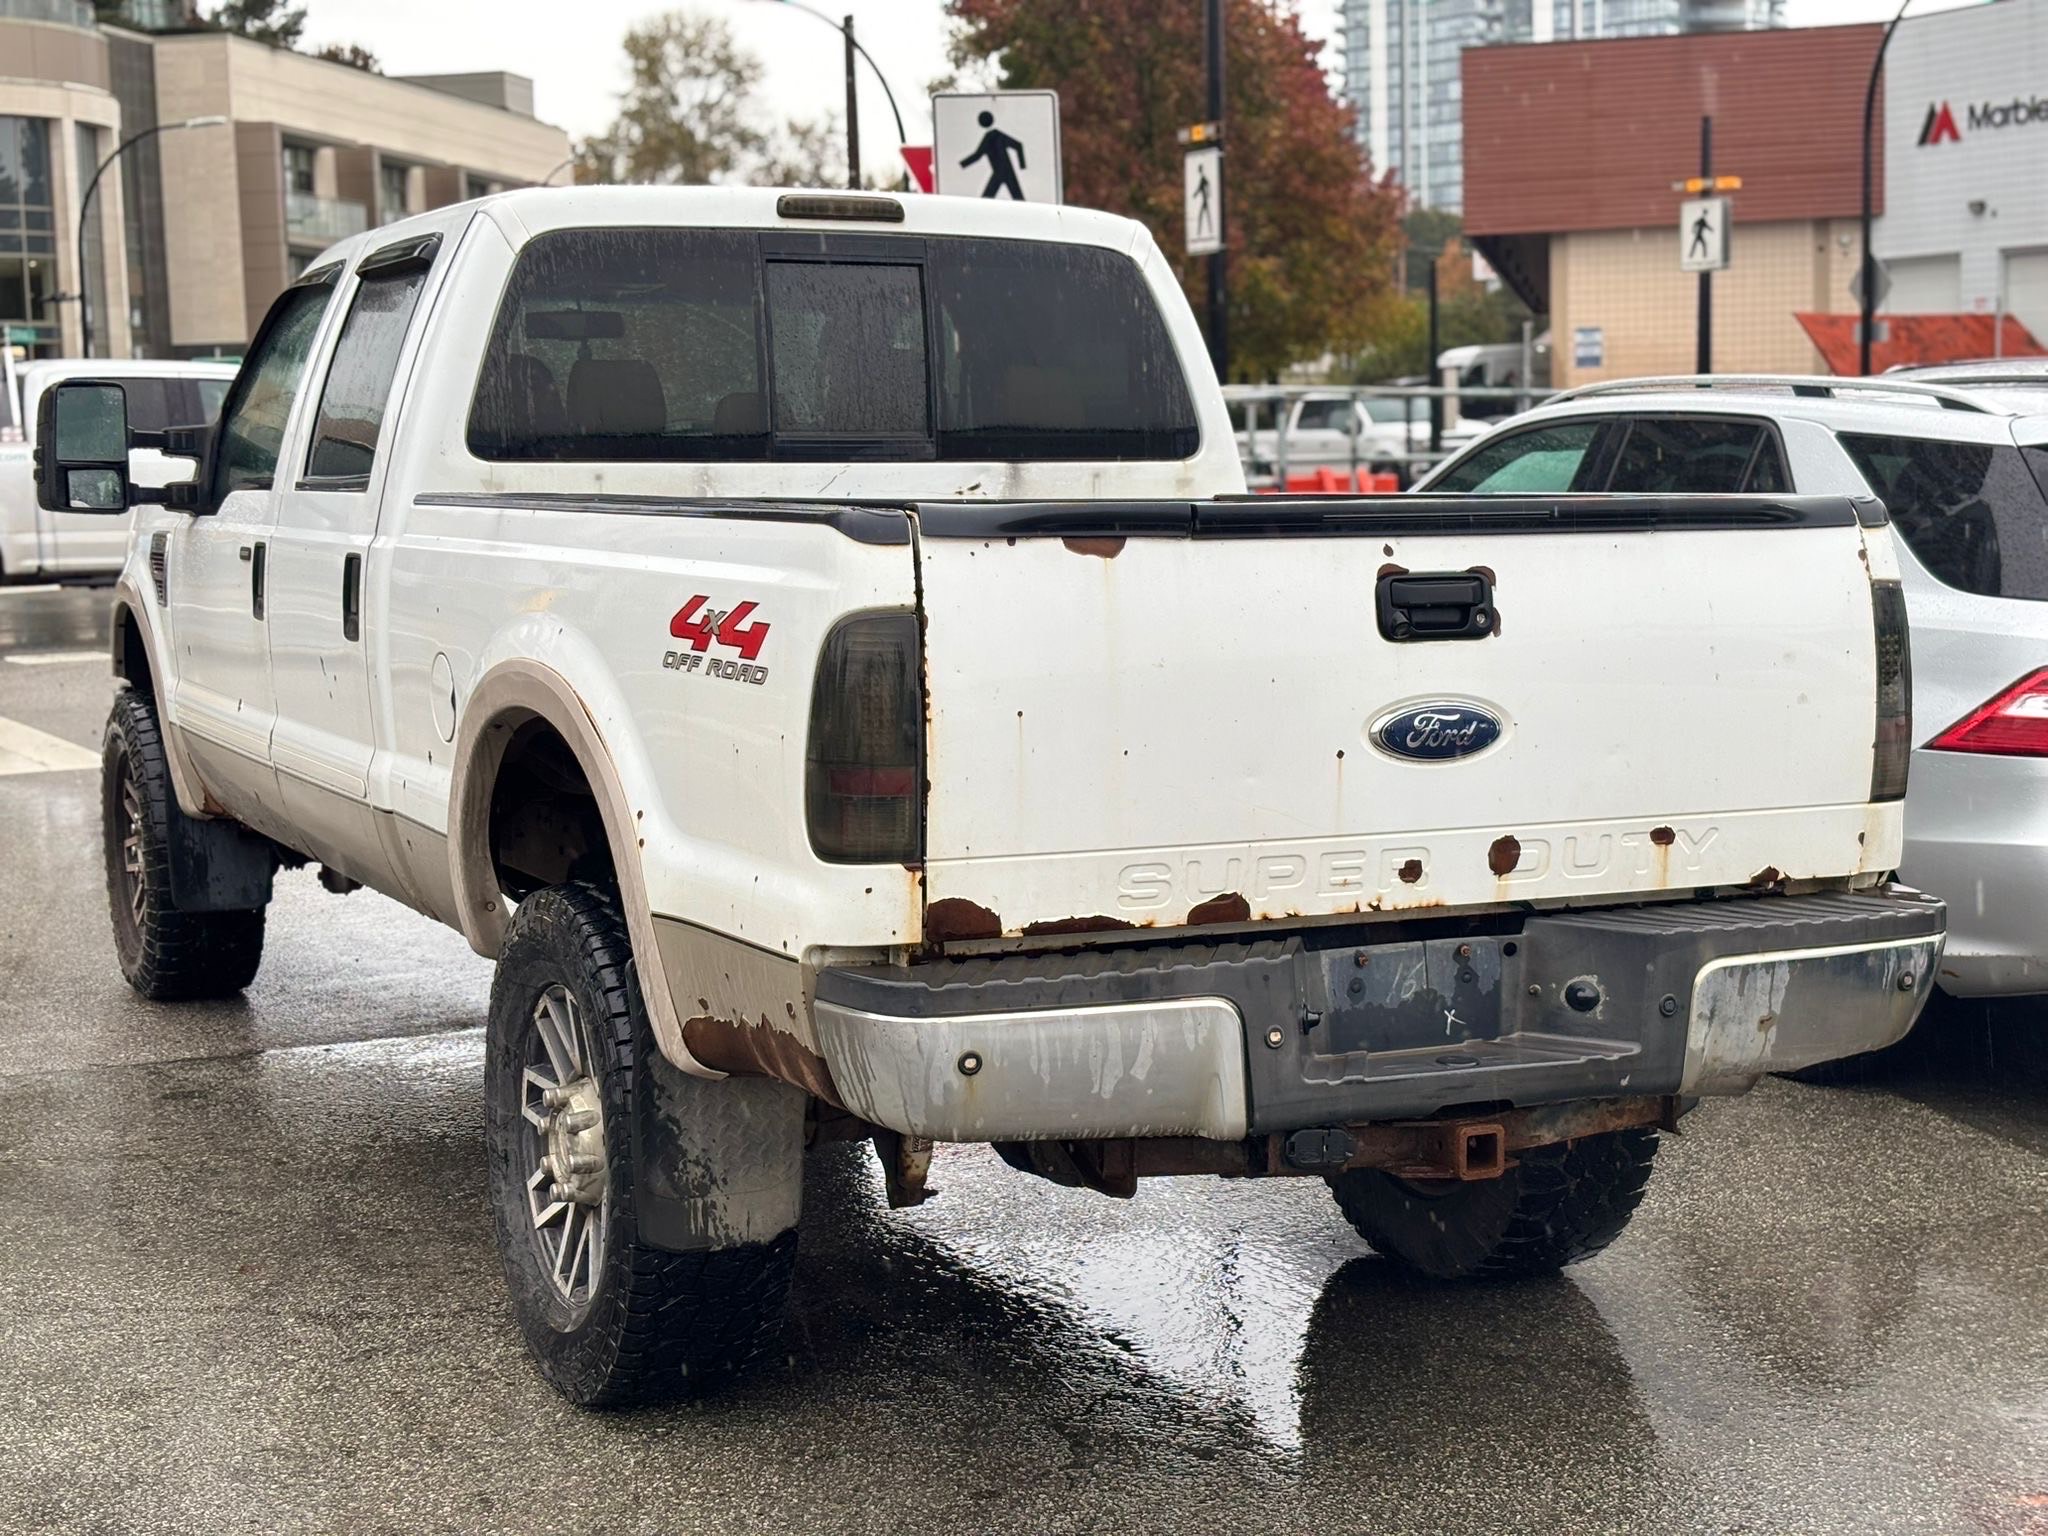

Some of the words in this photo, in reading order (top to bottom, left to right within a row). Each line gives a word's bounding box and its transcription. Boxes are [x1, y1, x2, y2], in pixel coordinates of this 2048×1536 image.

[662, 650, 703, 672] OFF
[705, 657, 769, 686] ROAD
[1406, 713, 1477, 748] Ford
[1117, 846, 1431, 910] SUPER
[1494, 827, 1719, 884] DUTY
